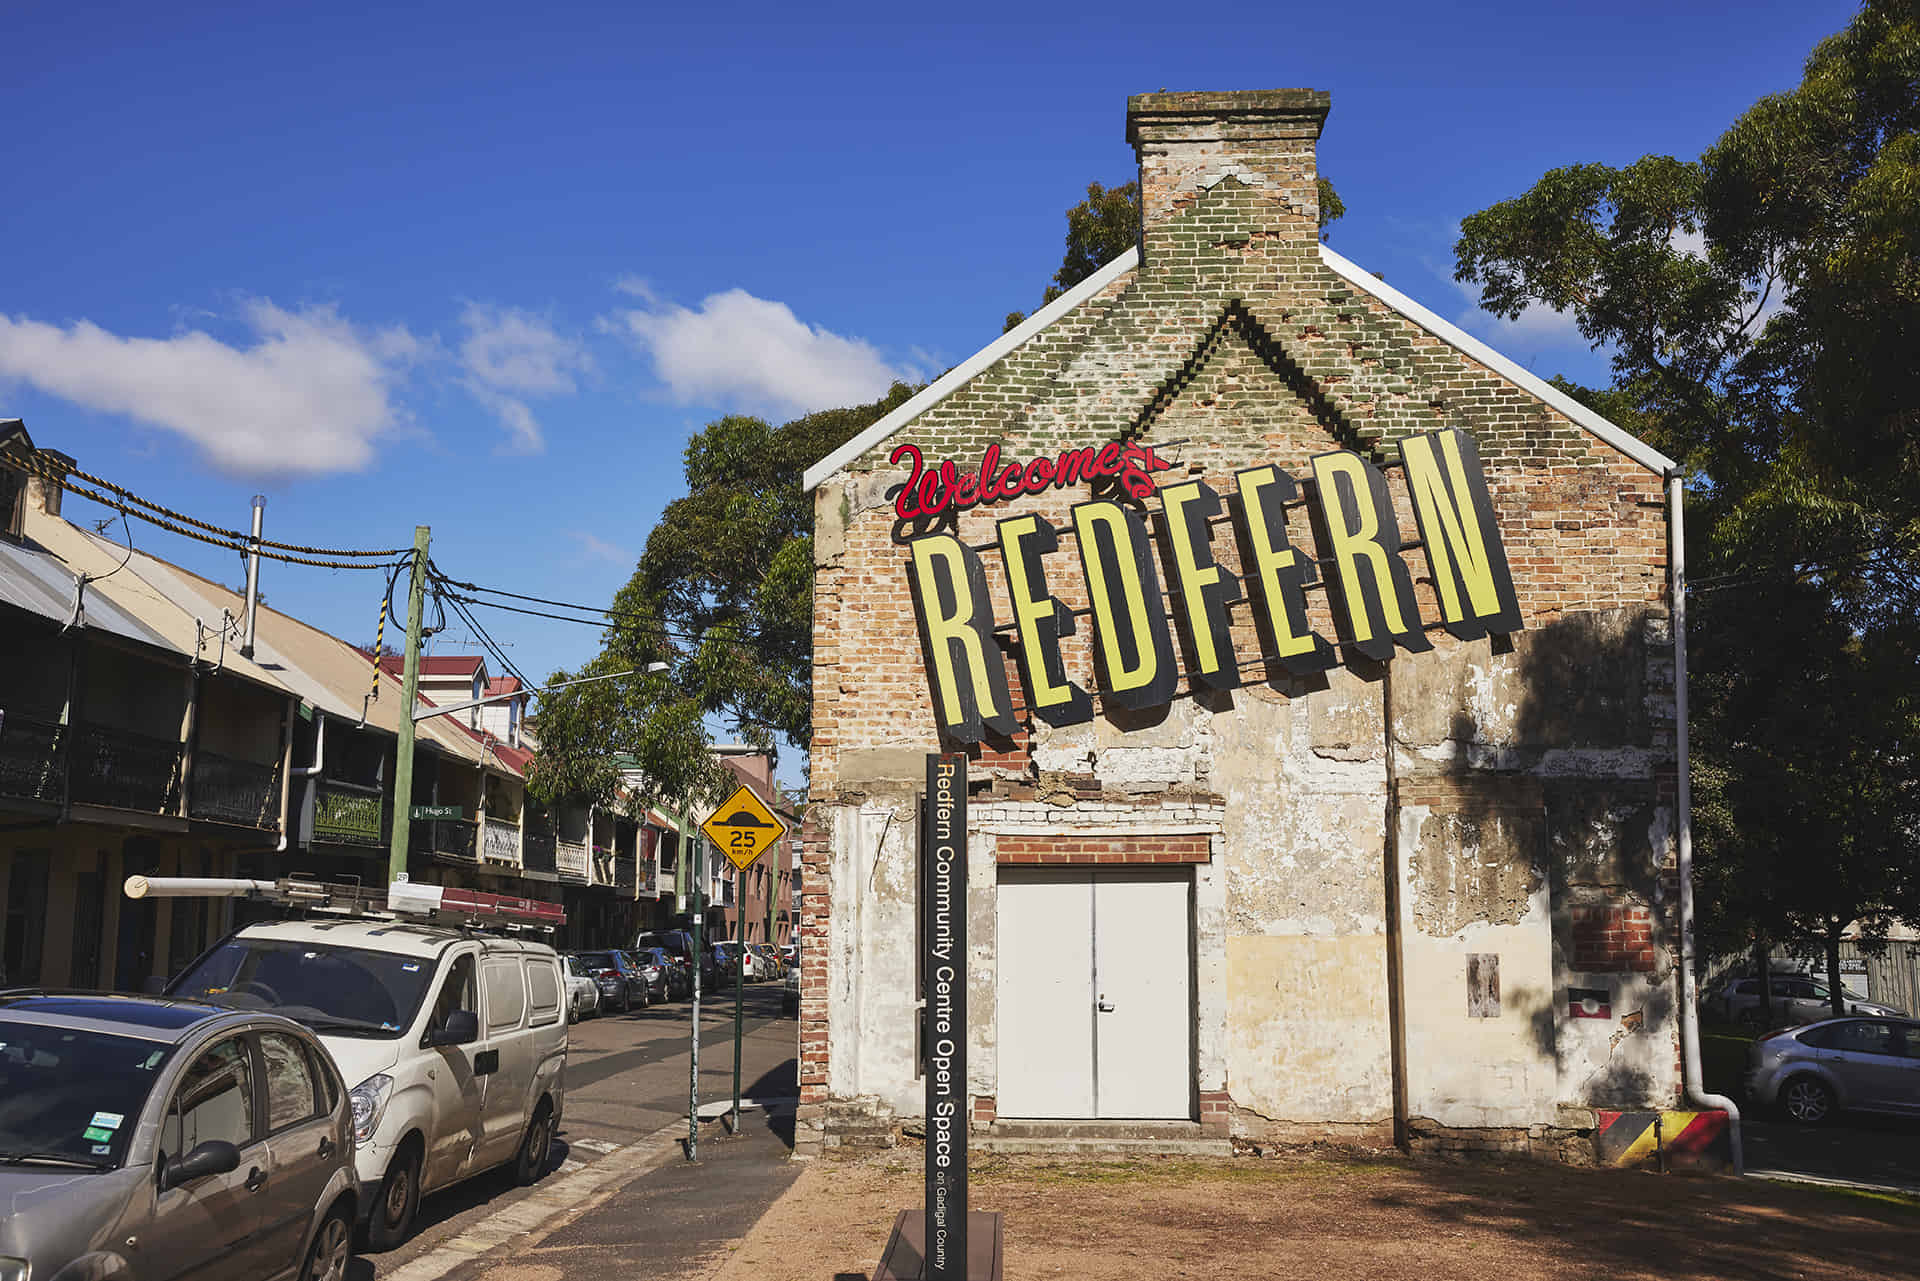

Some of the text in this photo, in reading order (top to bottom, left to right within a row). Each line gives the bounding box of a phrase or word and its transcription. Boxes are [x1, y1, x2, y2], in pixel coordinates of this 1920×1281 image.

[889, 441, 1125, 519] Welcome
[907, 428, 1512, 732] REDFERN
[730, 830, 756, 848] 25
[731, 848, 754, 857] km/h
[932, 763, 955, 1271] Redfern Community Centre Open Space on Gadigal Country
